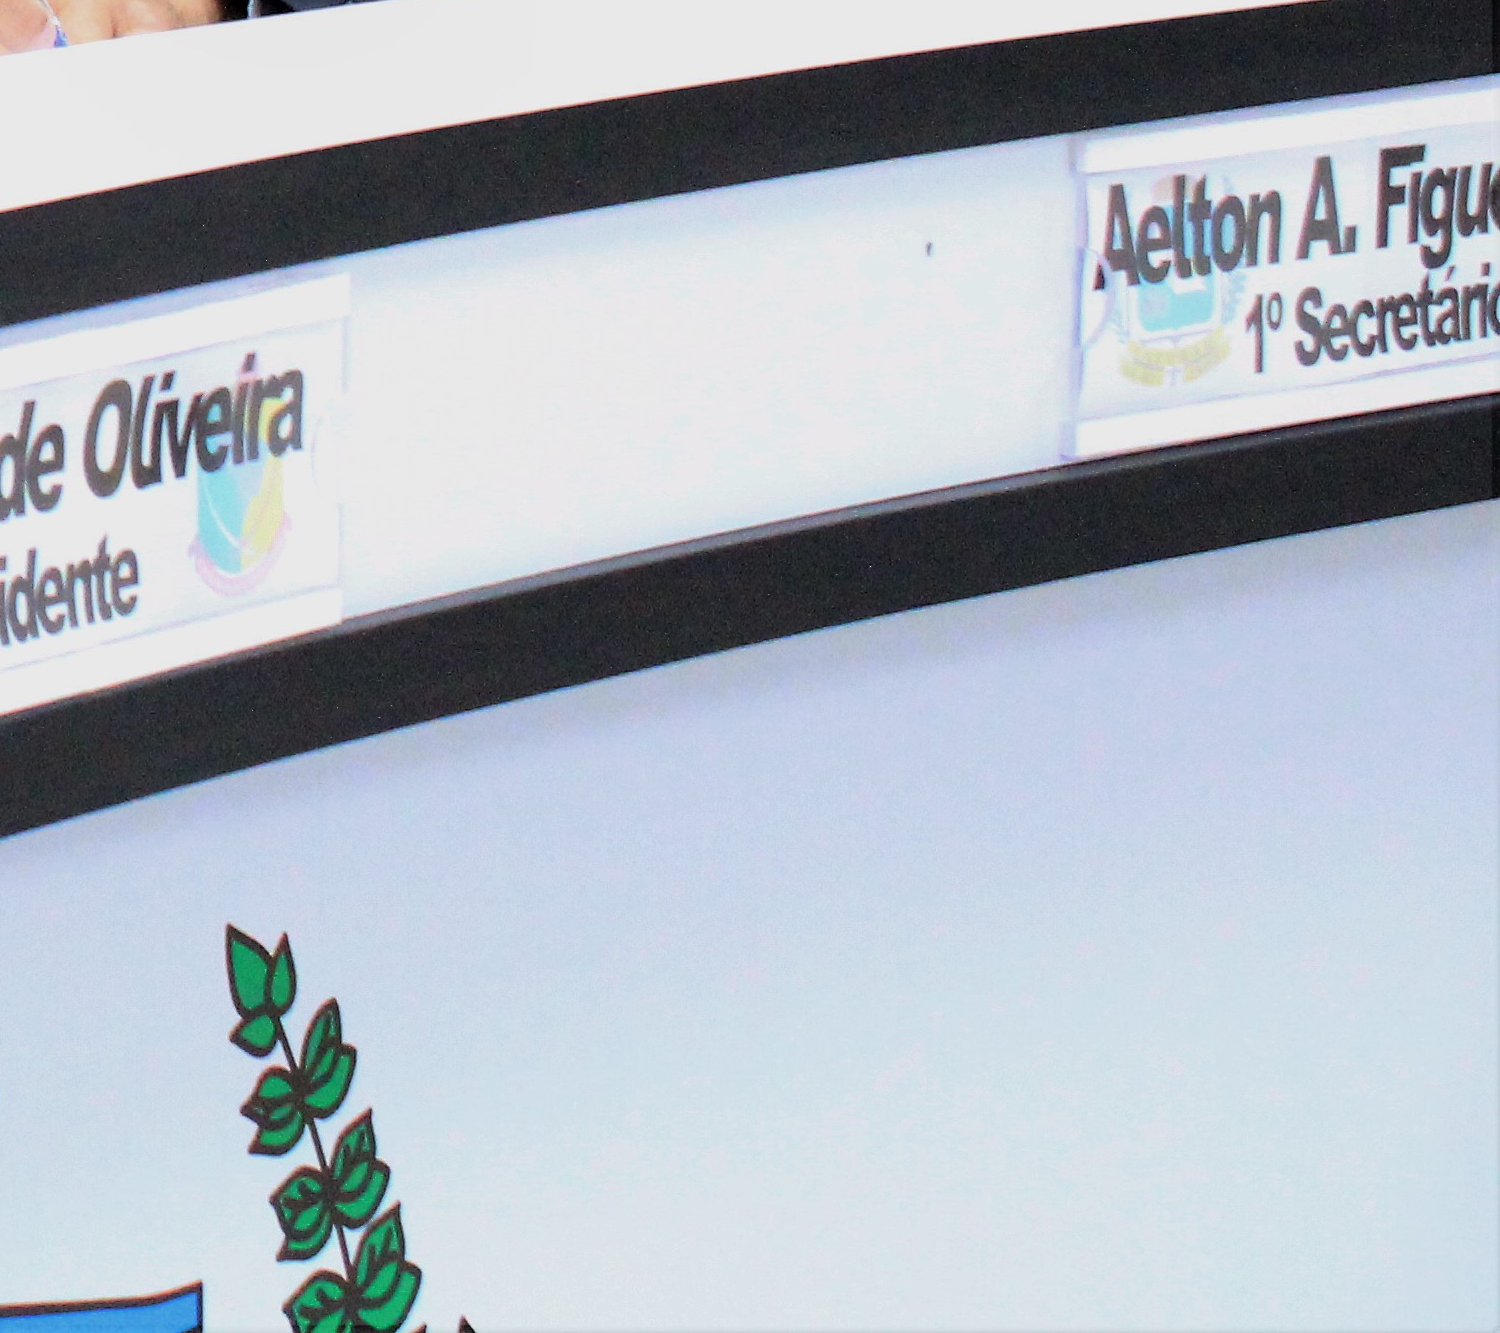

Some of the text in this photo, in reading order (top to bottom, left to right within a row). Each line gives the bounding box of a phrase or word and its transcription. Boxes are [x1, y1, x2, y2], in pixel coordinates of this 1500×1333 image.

[1093, 174, 1282, 291] Aelton
[1296, 155, 1357, 260] A.
[1245, 292, 1283, 374] 1º
[83, 352, 304, 498] Oliveira
